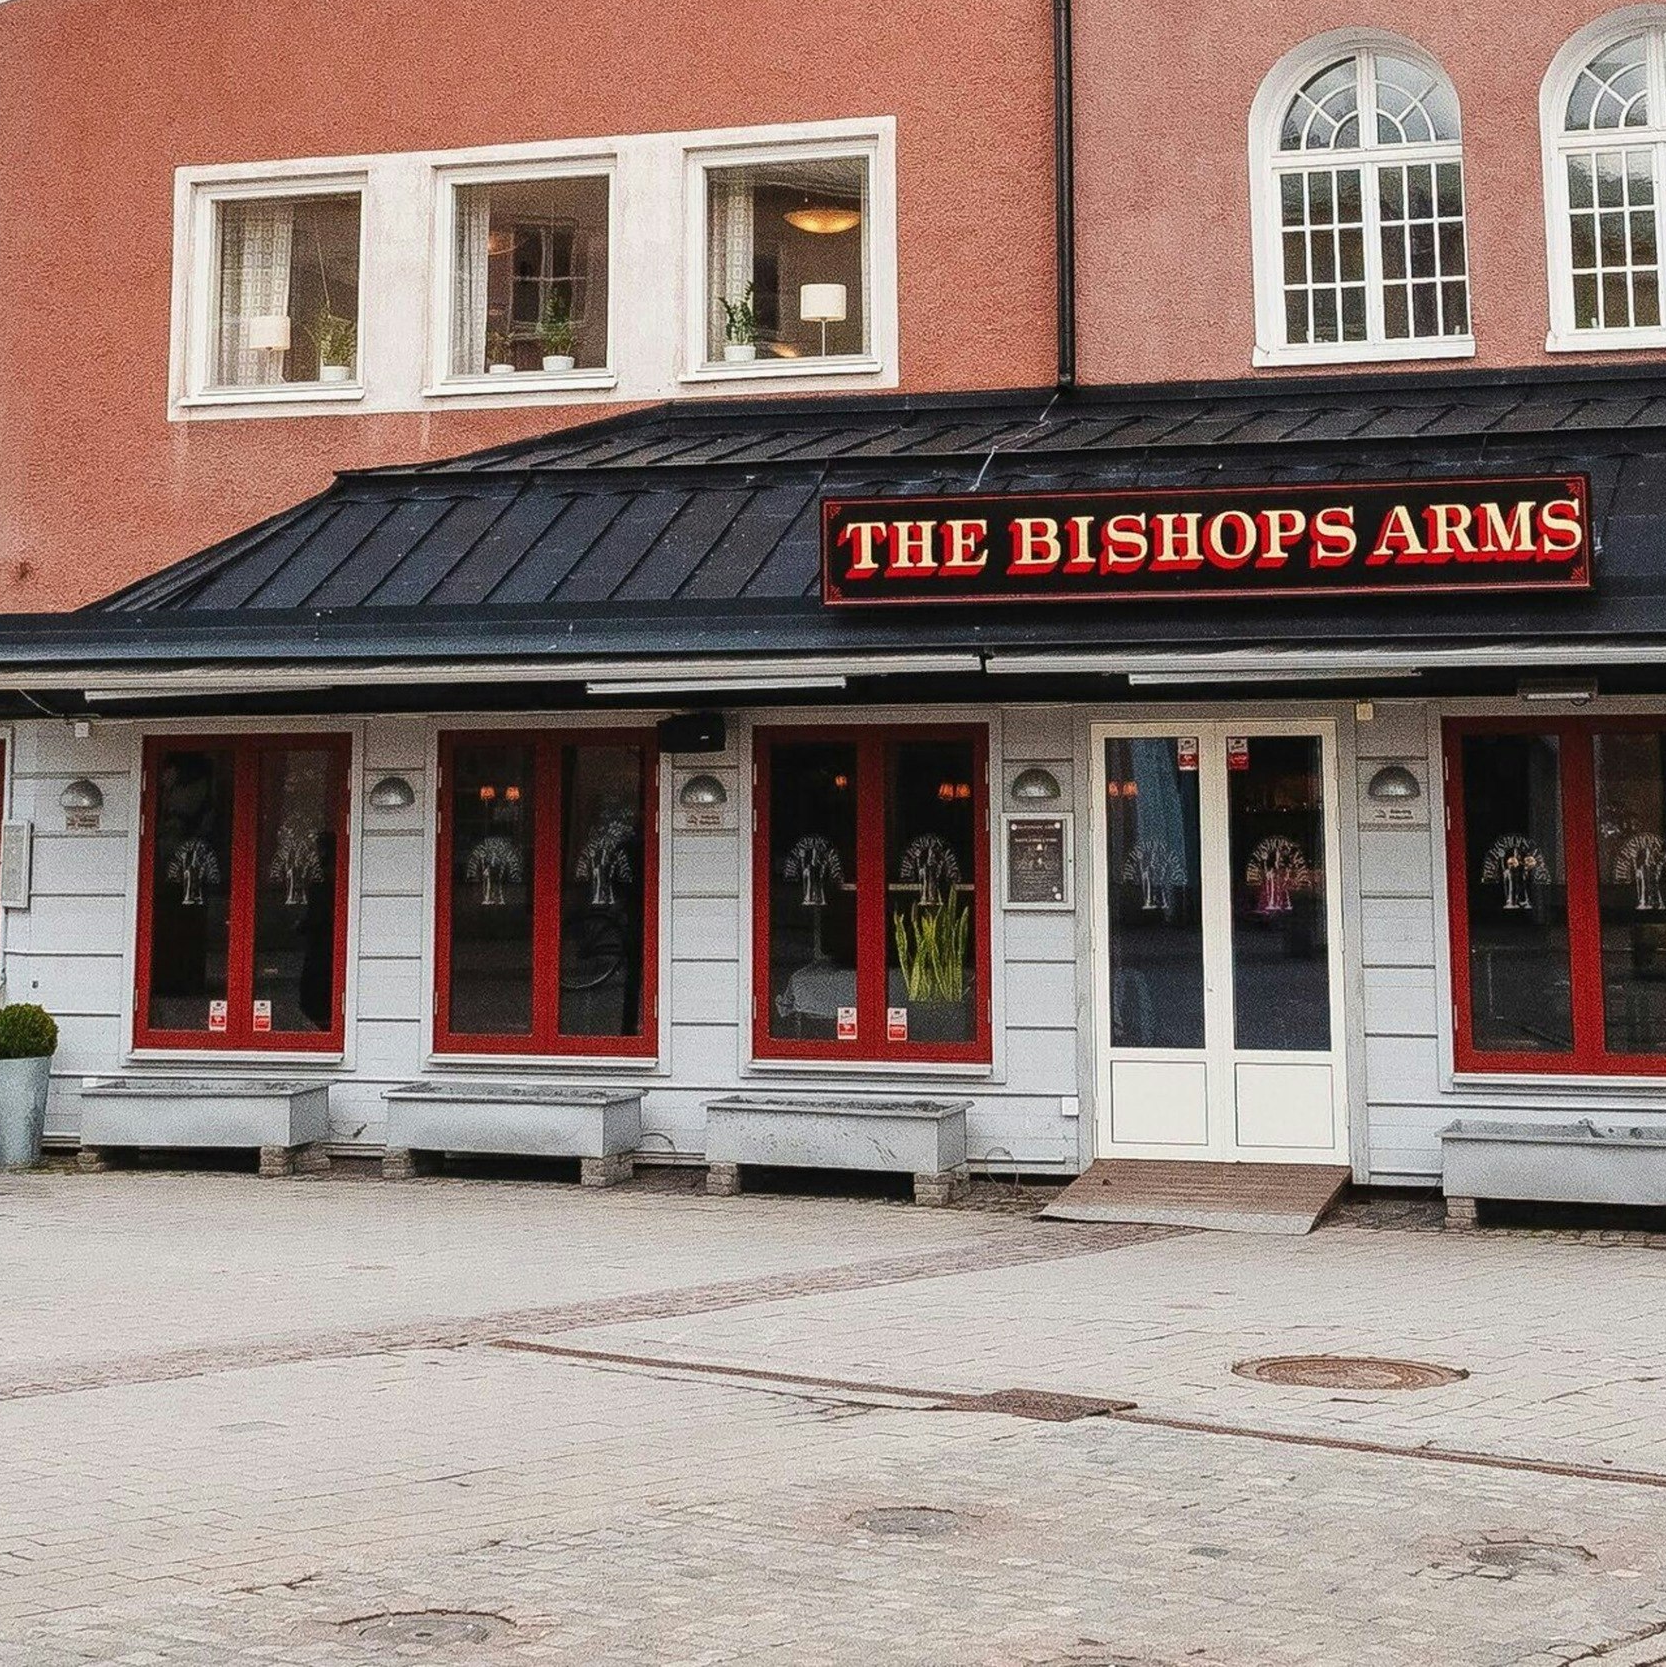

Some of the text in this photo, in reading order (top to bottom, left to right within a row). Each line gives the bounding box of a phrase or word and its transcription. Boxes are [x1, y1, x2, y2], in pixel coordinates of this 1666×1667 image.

[838, 499, 1583, 577] THE BISHOPS ARMS
